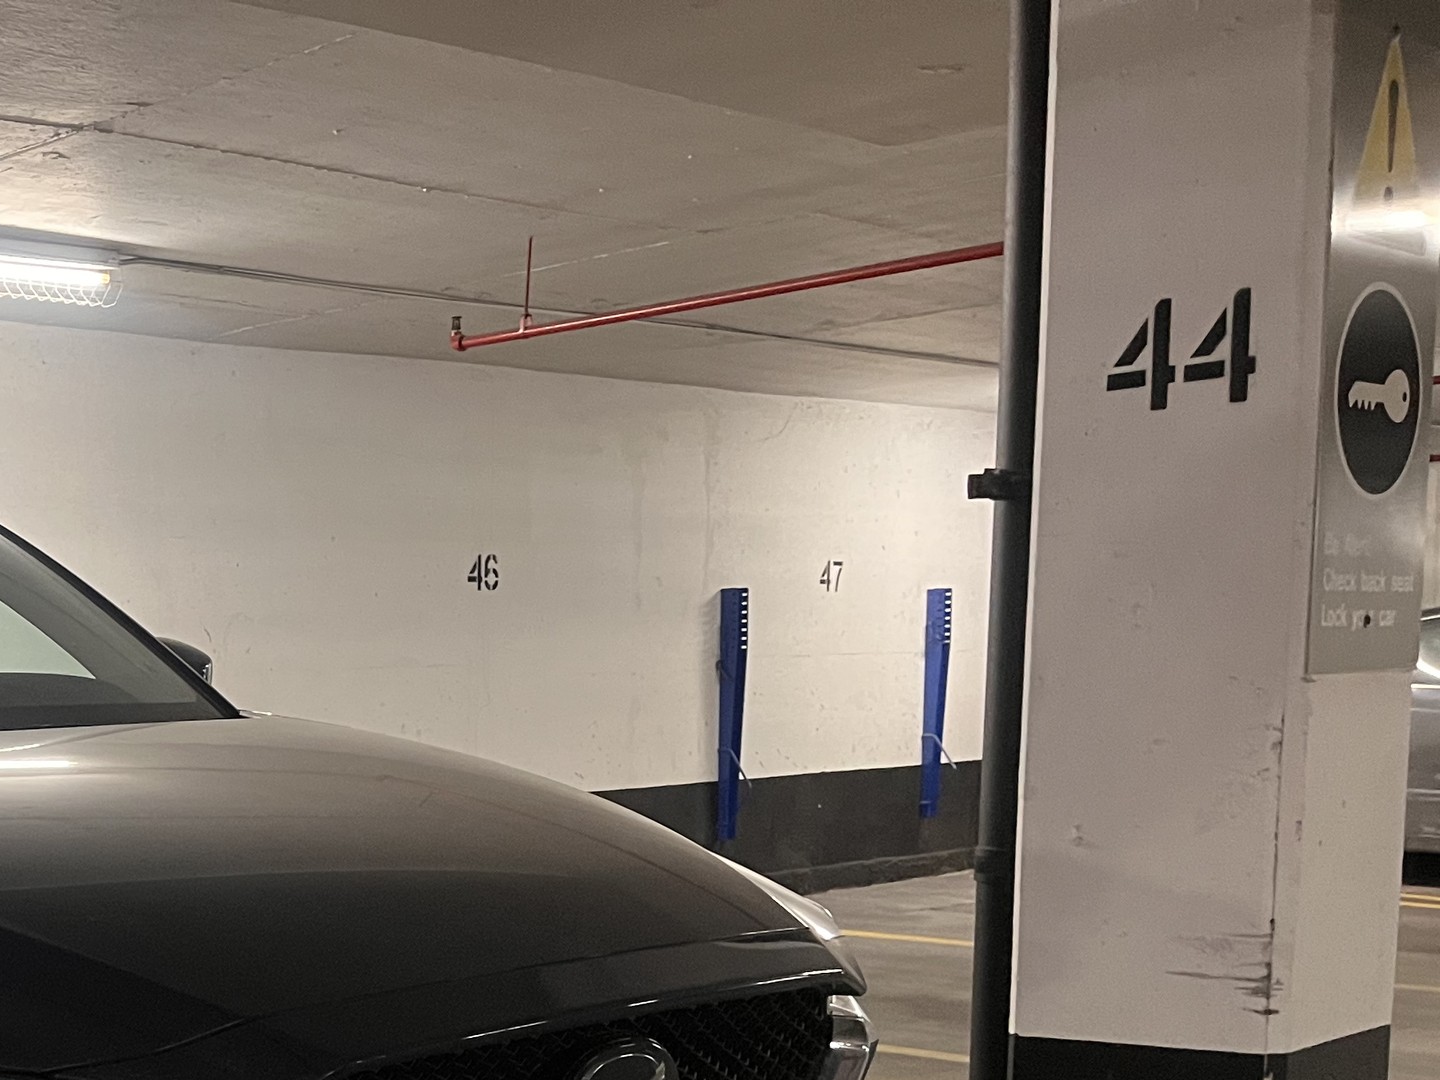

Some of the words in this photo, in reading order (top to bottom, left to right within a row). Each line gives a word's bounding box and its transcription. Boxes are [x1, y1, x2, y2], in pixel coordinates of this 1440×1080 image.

[1106, 286, 1257, 411] 44
[467, 553, 500, 592] 46
[819, 560, 844, 593] 47
[1323, 566, 1356, 592] Check
[1360, 568, 1386, 593] back
[1390, 570, 1415, 593] seat
[1321, 602, 1348, 627] Lock
[1378, 608, 1396, 627] car
